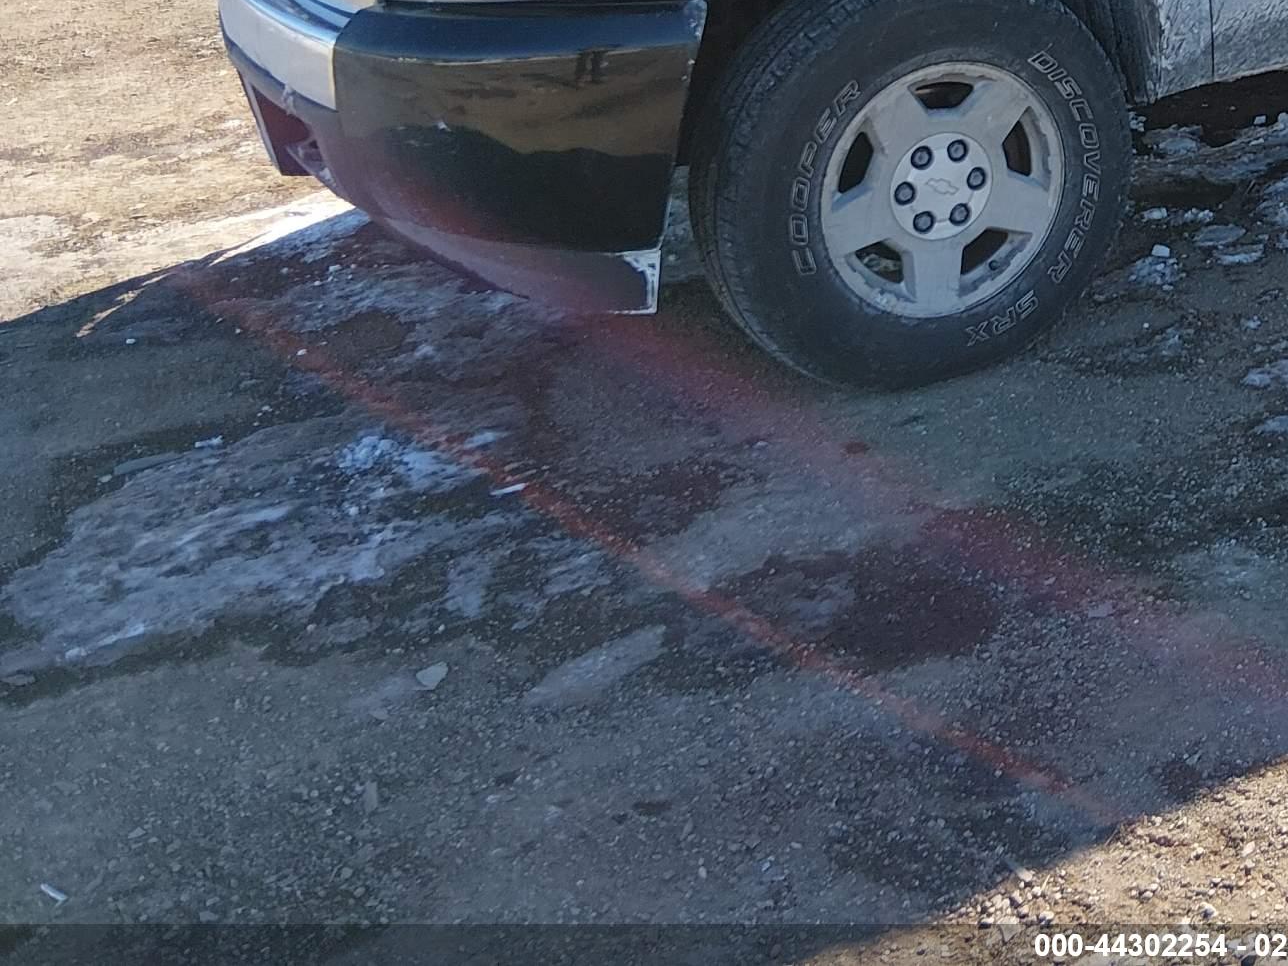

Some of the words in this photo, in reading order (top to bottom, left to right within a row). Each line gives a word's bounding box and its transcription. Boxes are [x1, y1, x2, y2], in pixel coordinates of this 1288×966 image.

[791, 80, 861, 276] COOPER
[1028, 50, 1101, 284] DISCOVERER
[966, 289, 1039, 347] SRX
